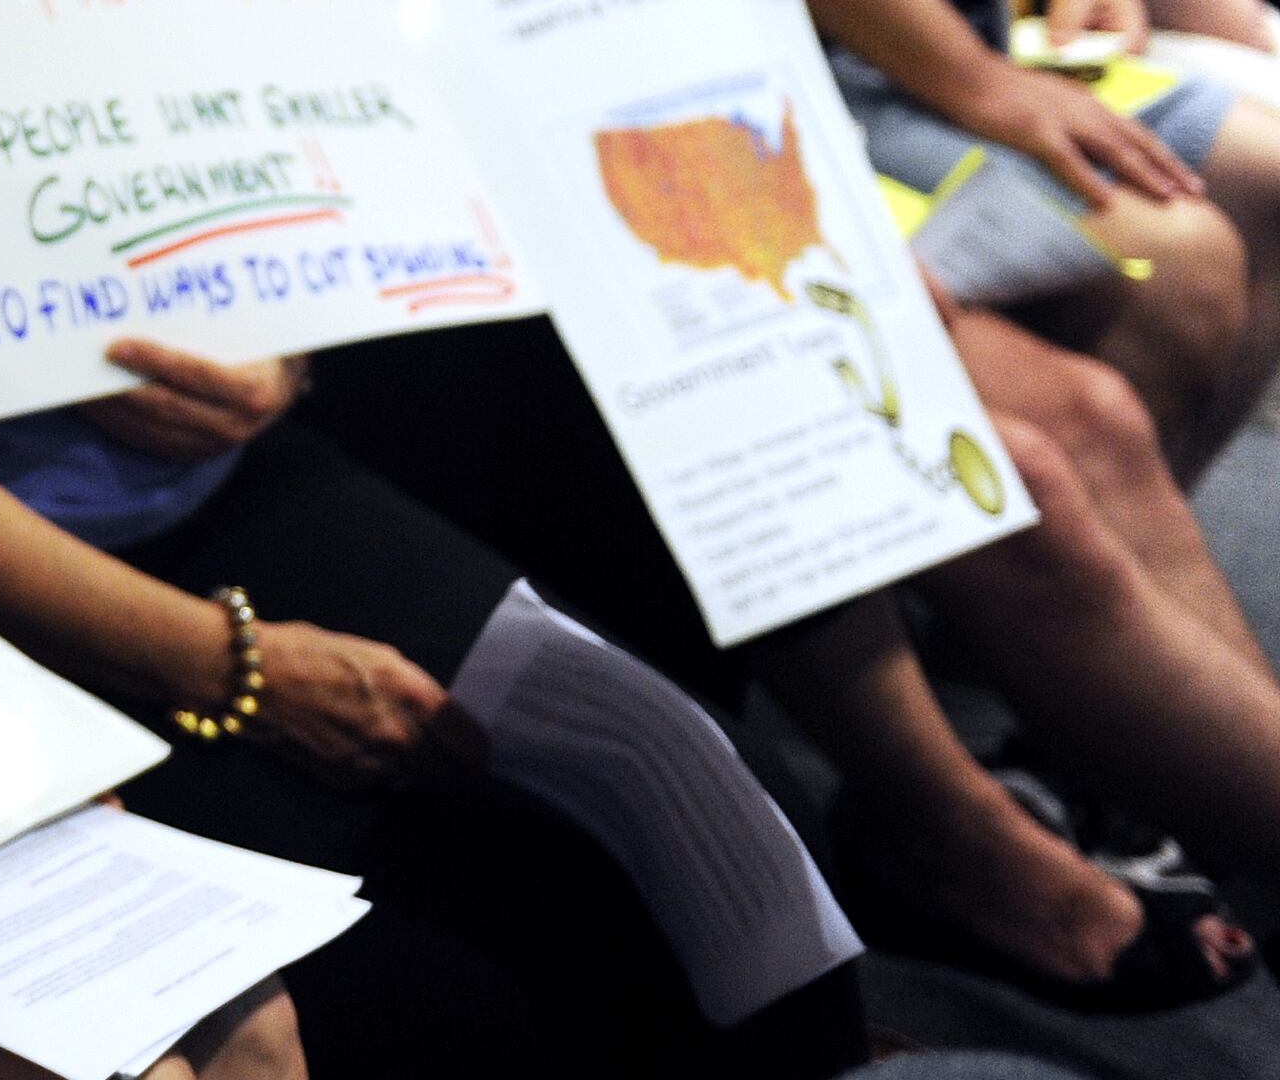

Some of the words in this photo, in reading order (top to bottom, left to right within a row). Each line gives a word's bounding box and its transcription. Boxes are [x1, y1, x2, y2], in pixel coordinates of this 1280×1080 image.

[160, 86, 246, 134] WANT
[37, 277, 130, 325] FIND
[143, 263, 236, 316] WAYS
[241, 254, 291, 302] TO
[297, 245, 351, 296] CUT
